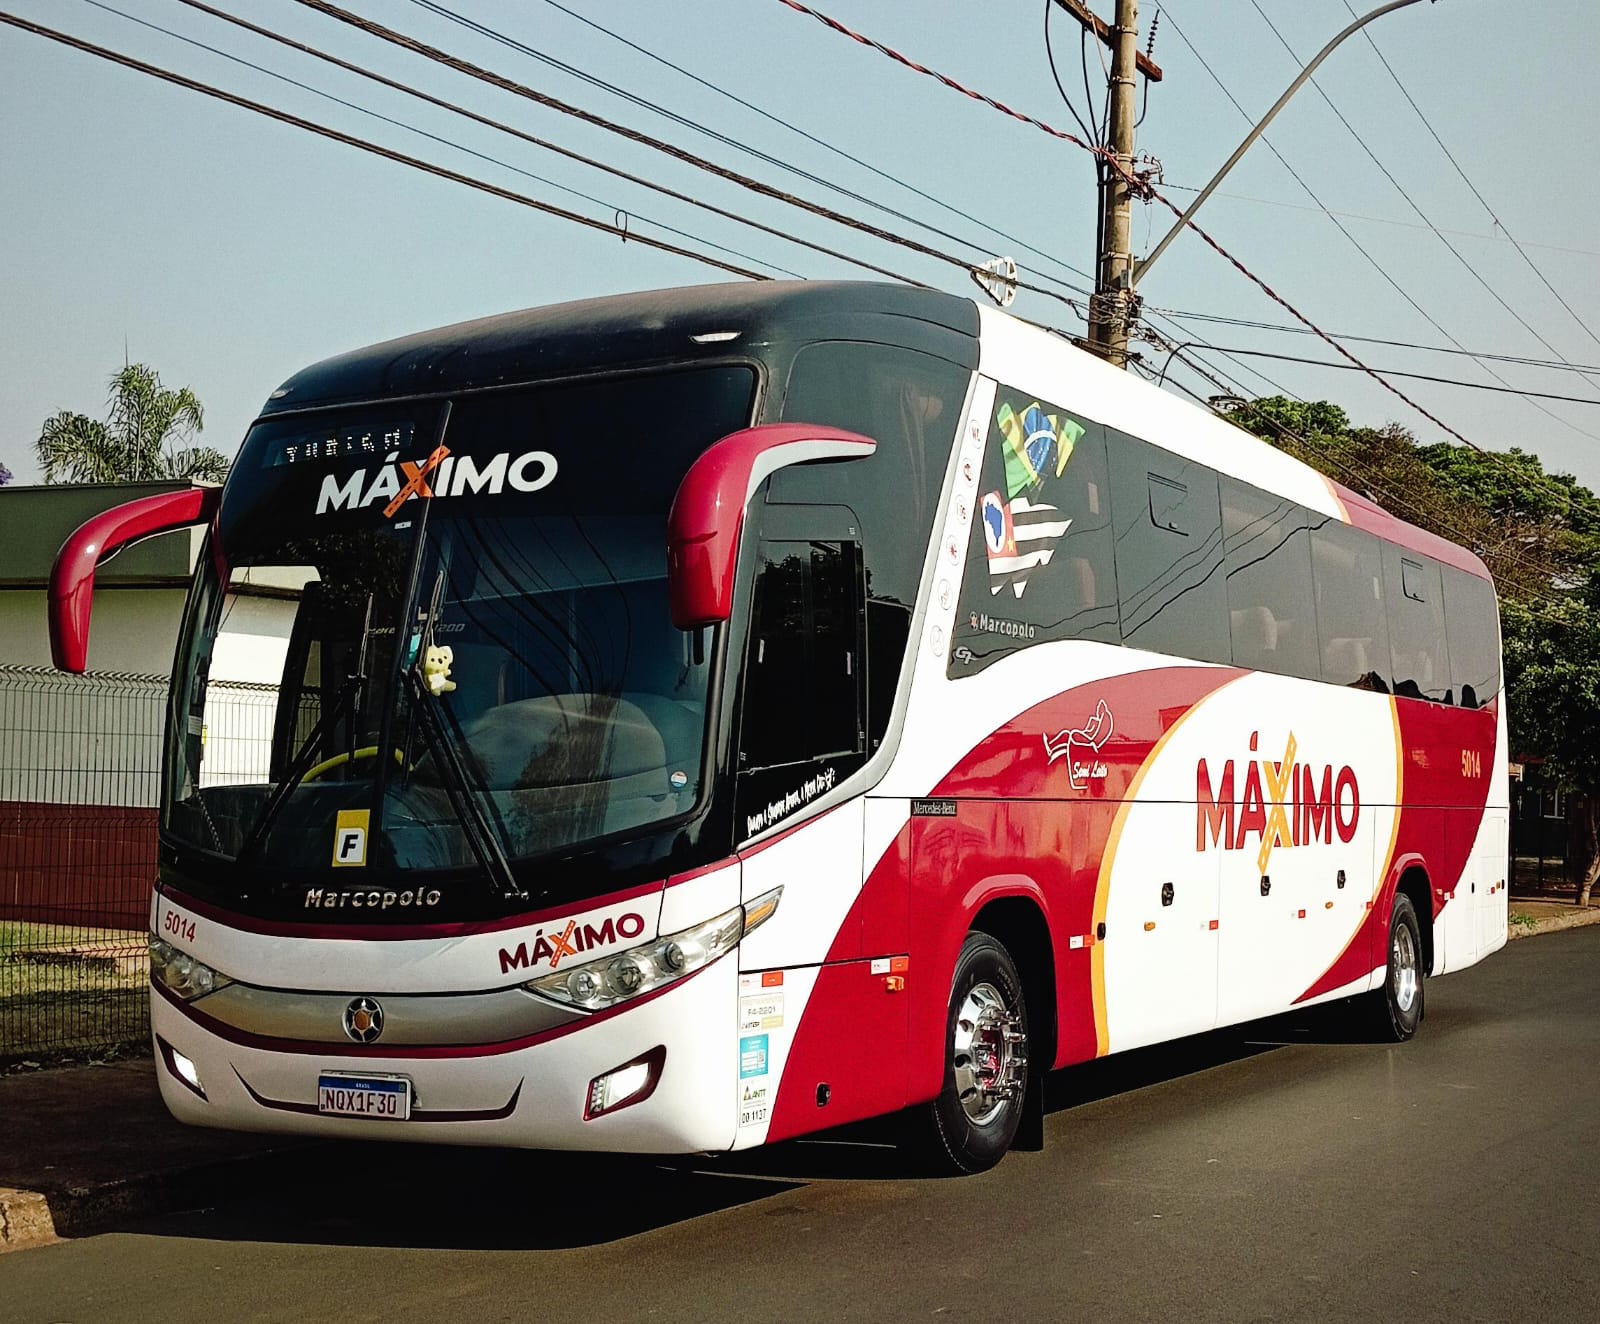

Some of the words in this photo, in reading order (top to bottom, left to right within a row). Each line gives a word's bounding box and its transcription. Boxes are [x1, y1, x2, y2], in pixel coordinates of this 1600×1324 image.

[315, 444, 559, 519] MÁXIMO
[980, 613, 1035, 639] Marcopolo
[1461, 749, 1481, 778] 5014
[913, 801, 956, 815] Mercedes-Benz
[1196, 730, 1360, 876] MÁXIMO
[340, 834, 359, 858] F
[304, 886, 442, 910] Marcopolo
[164, 910, 196, 943] 5014
[498, 912, 645, 975] MÁXIMO
[326, 1089, 397, 1115] NQX1F30
